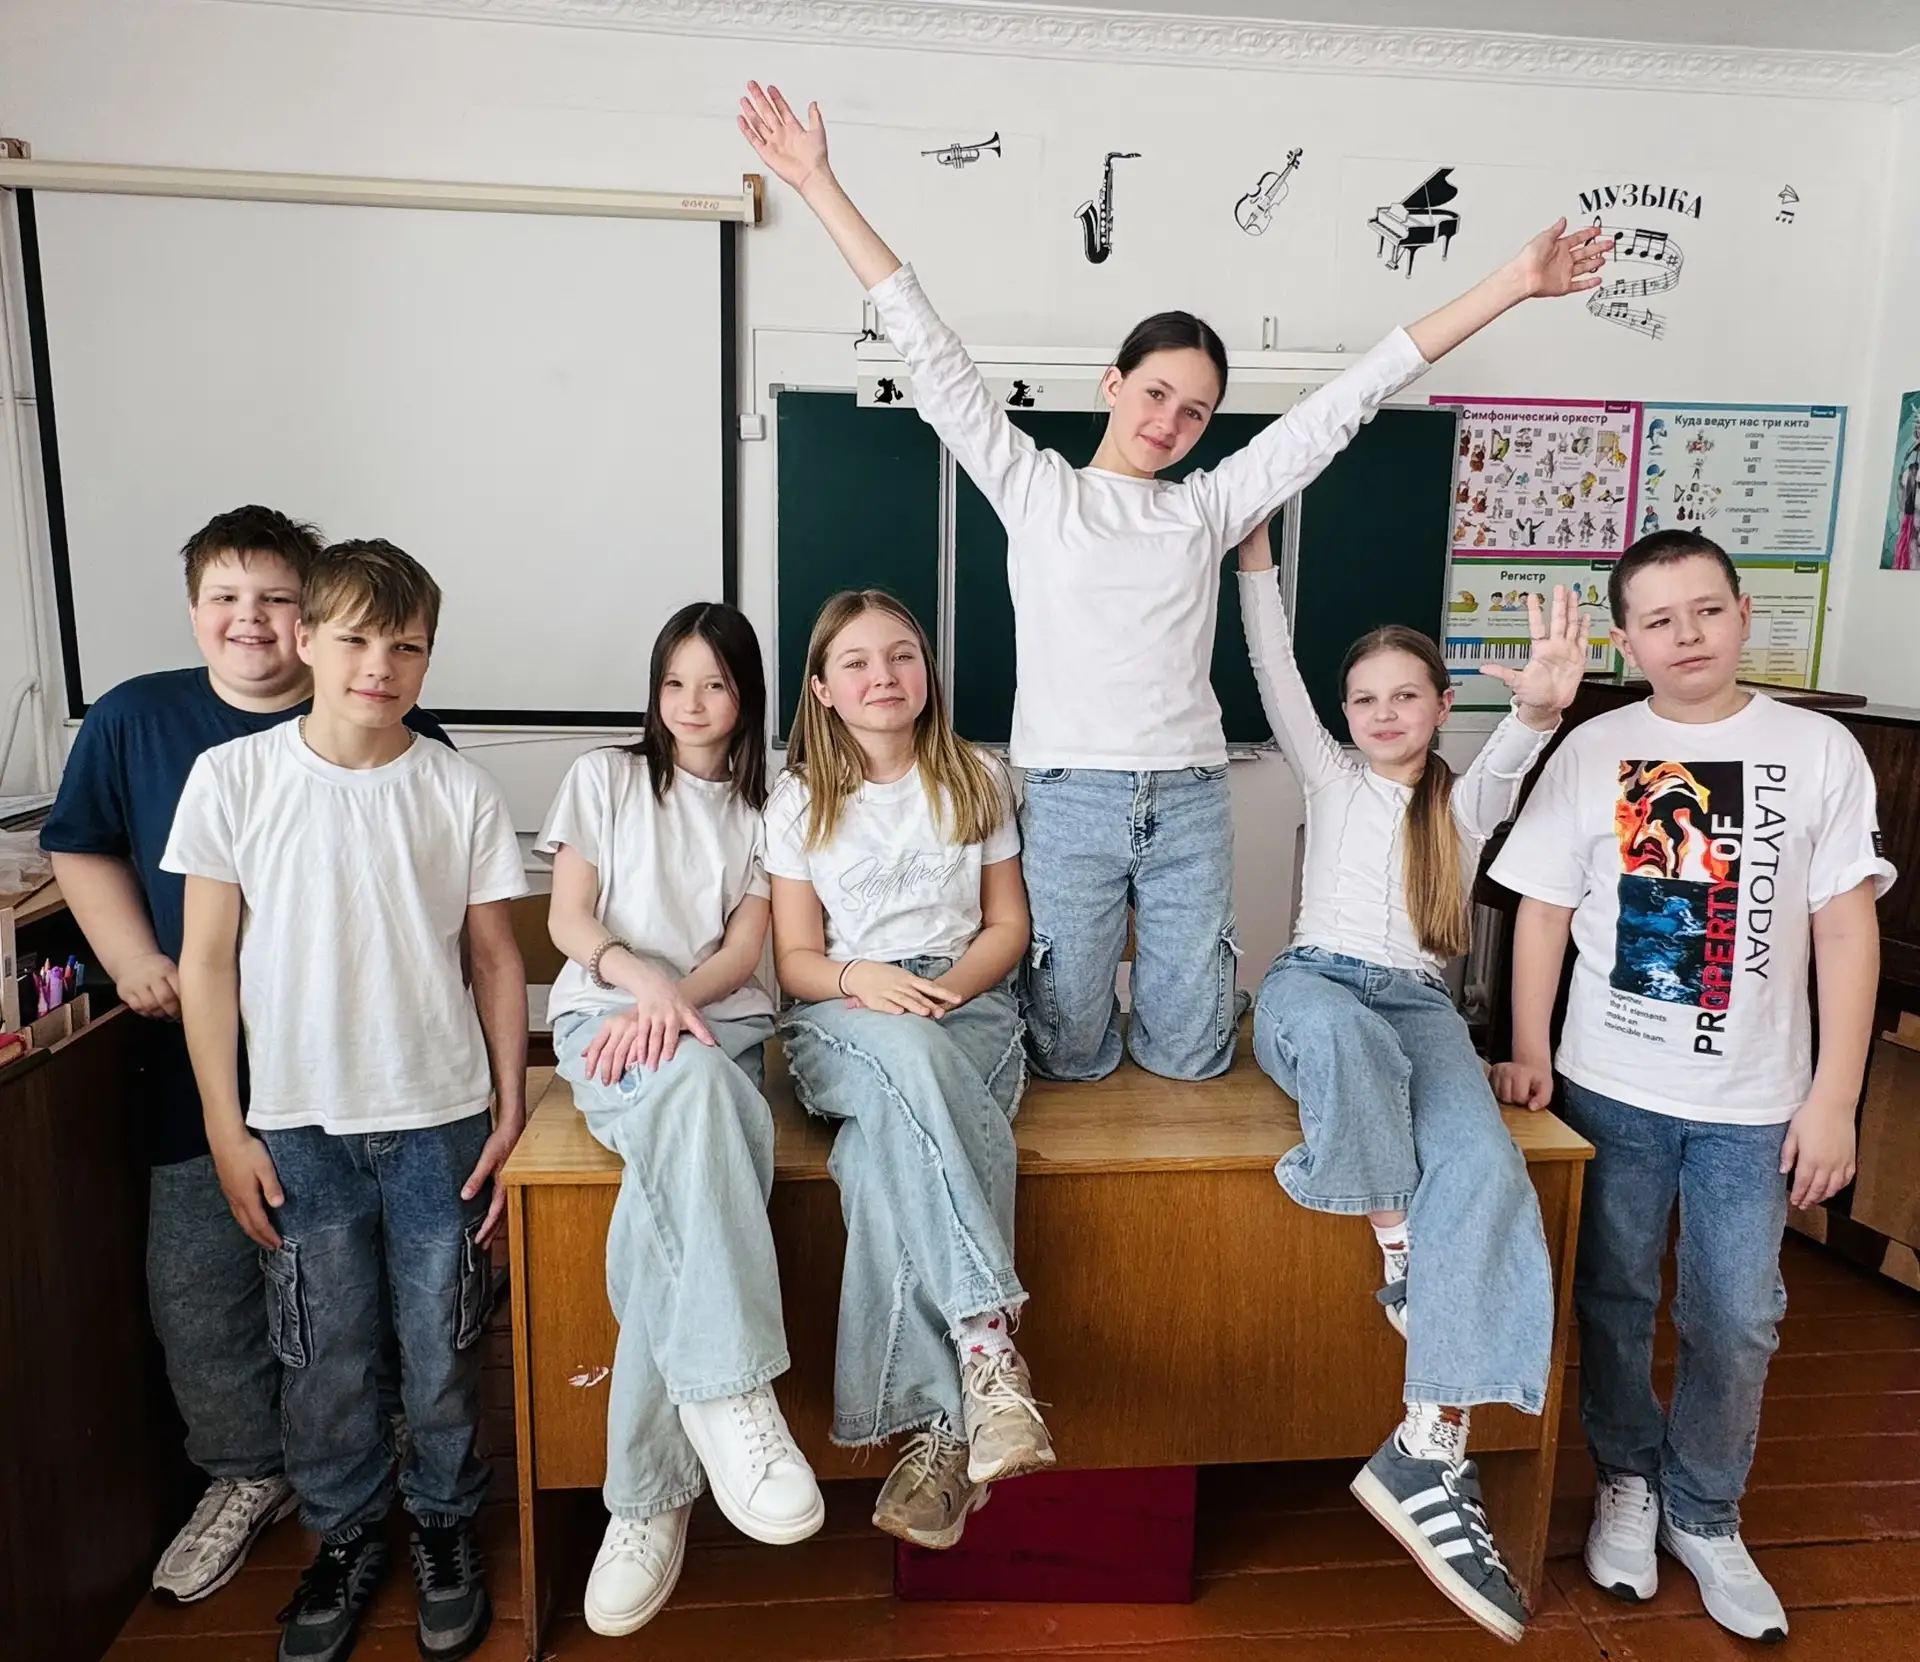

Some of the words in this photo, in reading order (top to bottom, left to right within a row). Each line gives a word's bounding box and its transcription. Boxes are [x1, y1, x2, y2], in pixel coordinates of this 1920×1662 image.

[1578, 183, 1702, 219] МУЗЫКА
[1462, 409, 1559, 423] Симфонический
[1561, 413, 1608, 426] оркестр
[1674, 415, 1702, 428] Куда
[1704, 417, 1738, 428] ведут
[1740, 418, 1759, 427] нас
[1762, 418, 1781, 429] три
[1784, 419, 1810, 428] кита
[1500, 570, 1546, 584] Регистр
[1710, 813, 1743, 862] OF
[1744, 763, 1787, 980] PLAYTODAY
[1693, 872, 1740, 1057] PROPERTY
[1605, 1010, 1627, 1023] make
[1627, 1018, 1639, 1026] an
[1610, 999, 1621, 1010] the
[1629, 1007, 1668, 1023] elements
[1604, 1020, 1642, 1038] invincible
